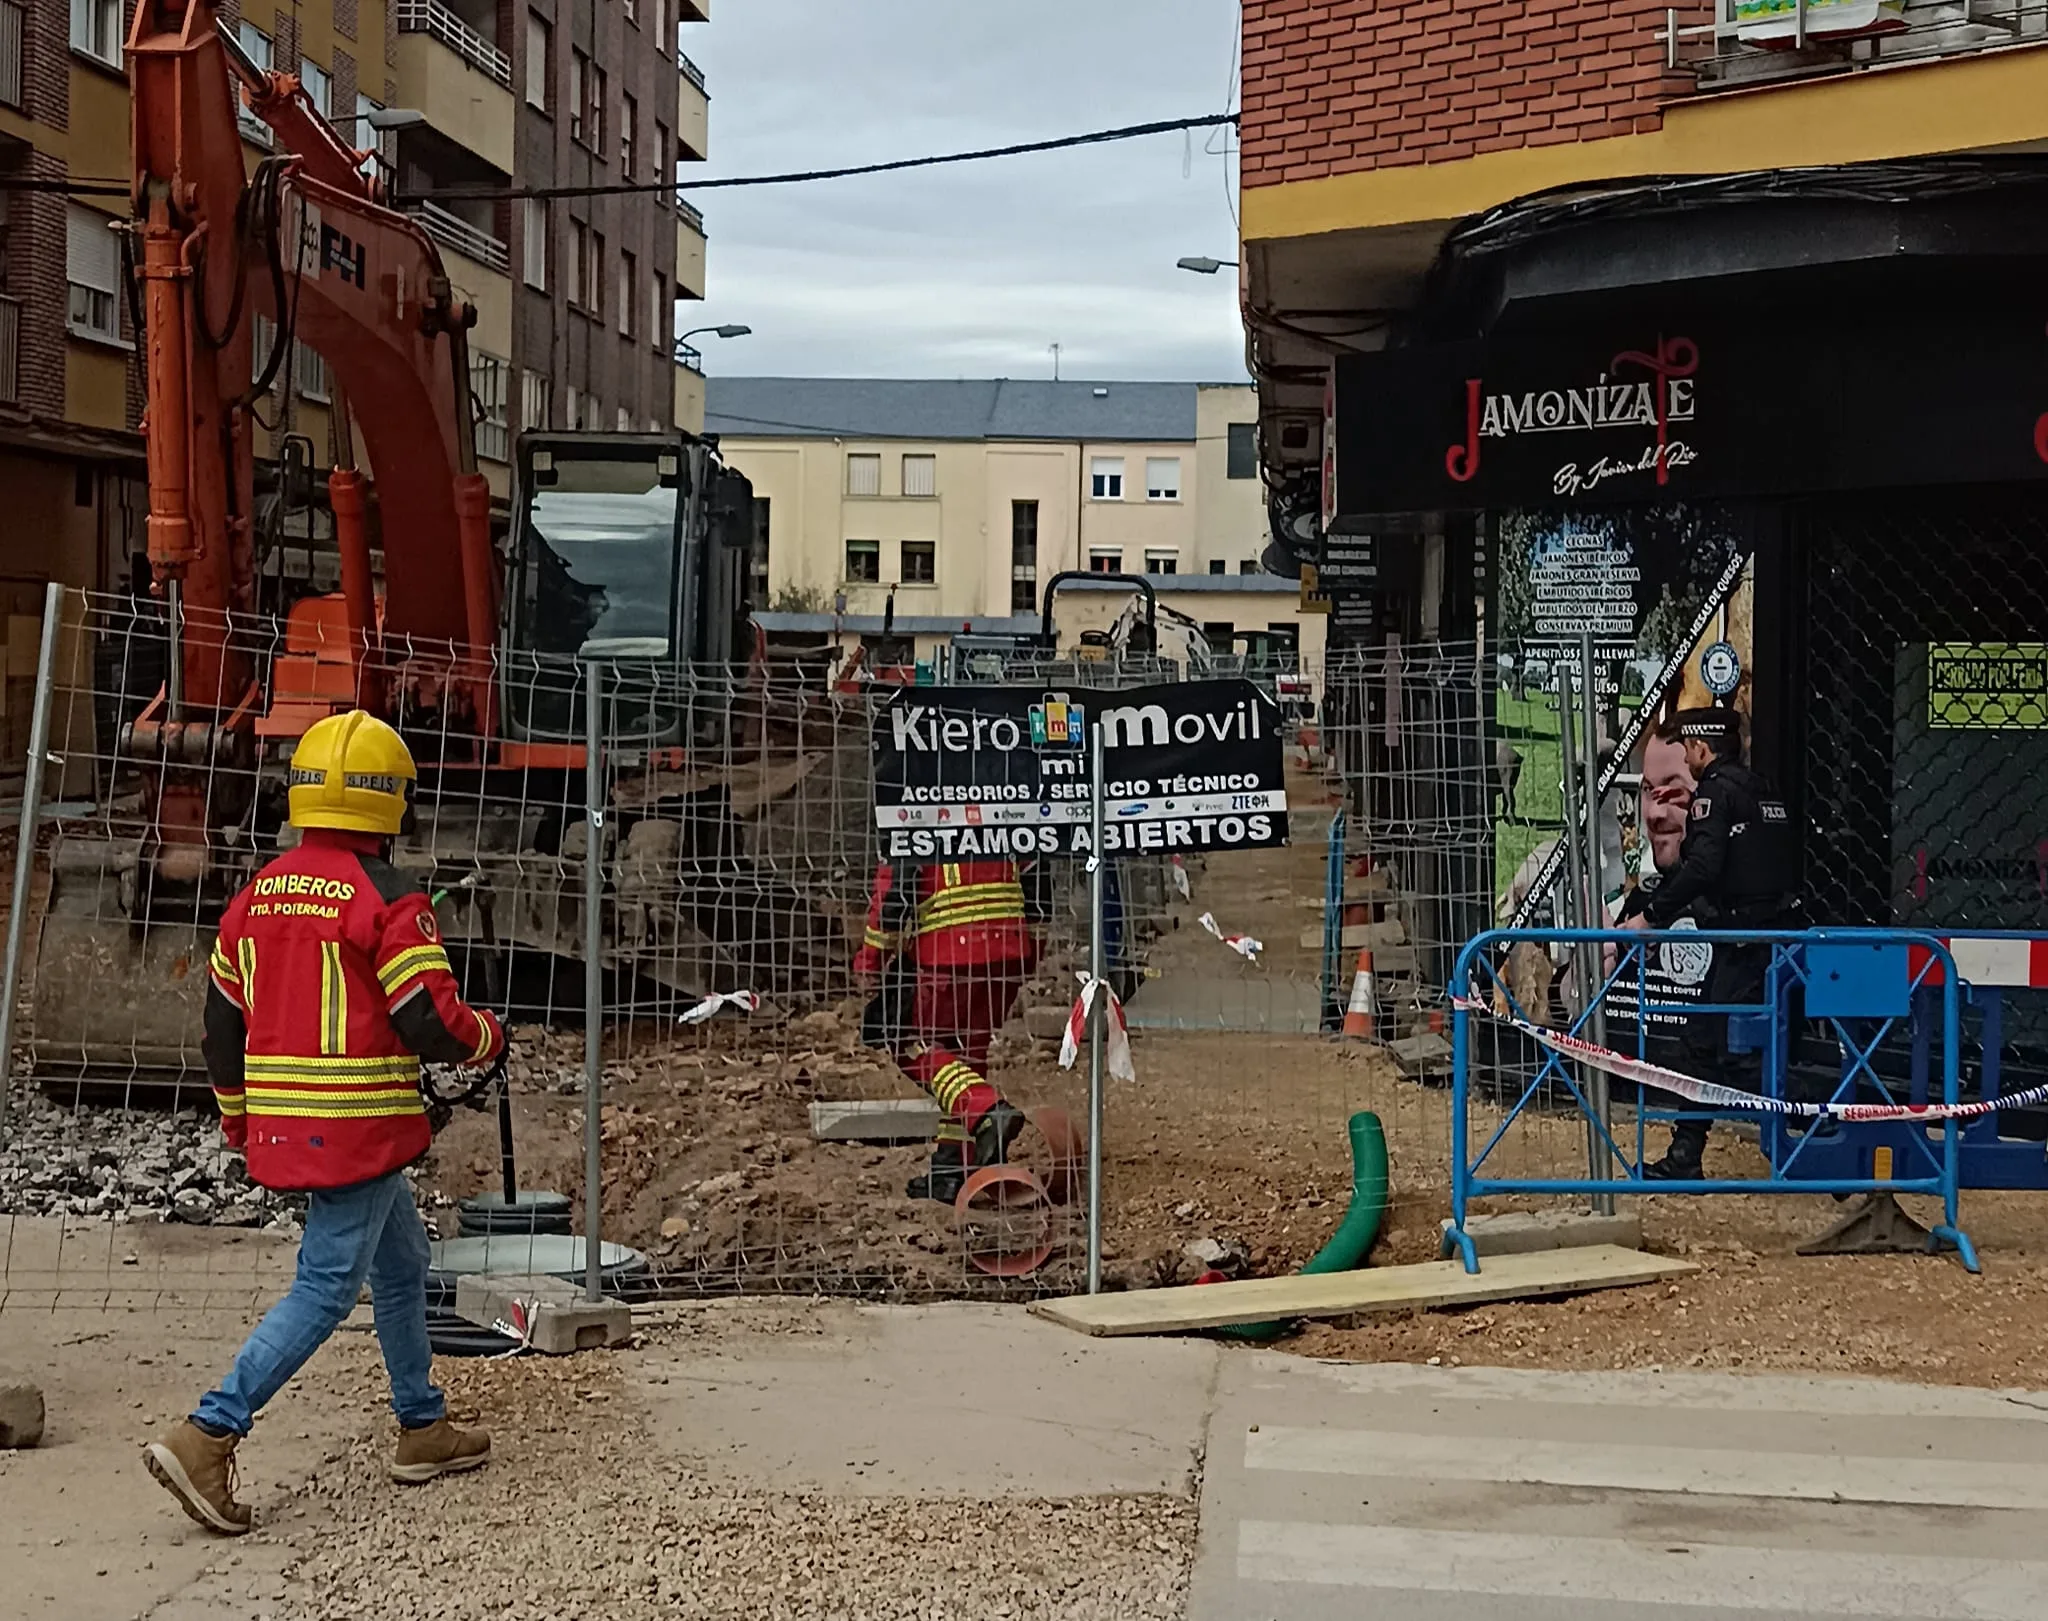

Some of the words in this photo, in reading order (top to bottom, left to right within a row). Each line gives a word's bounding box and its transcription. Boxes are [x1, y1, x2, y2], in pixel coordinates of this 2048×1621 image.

[1445, 332, 1699, 486] JAMONÍZATE
[1554, 462, 1582, 496] By
[1582, 456, 1635, 489] Javier
[1637, 444, 1665, 470] del
[1530, 569, 1571, 582] JAMONES
[1573, 569, 1598, 580] GRAN
[1599, 567, 1639, 580] RESERVA
[1537, 585, 1588, 599] EMBUTIDOS
[1532, 602, 1583, 616] EMBUTIDOS
[1603, 602, 1637, 615] BIERZO
[1536, 620, 1587, 633] CONSERVAS
[1589, 619, 1632, 632] PREMIUM
[1601, 648, 1635, 659] LLEVAR
[1614, 720, 1642, 762] EVENTOS
[1640, 687, 1662, 718] CATAS
[1660, 638, 1692, 687] PRIVADOS
[1690, 602, 1713, 637] MESAS
[1708, 588, 1722, 608] DE
[1716, 552, 1744, 593] QUESOS
[891, 706, 1020, 752] Kiero
[1101, 699, 1260, 748] movil
[1041, 754, 1084, 775] mi
[901, 783, 1030, 802] ACCESORIOS
[1051, 778, 1150, 800] SERICIO
[1157, 773, 1260, 794] TÉCNICO
[890, 826, 1060, 857] ESTAMOS
